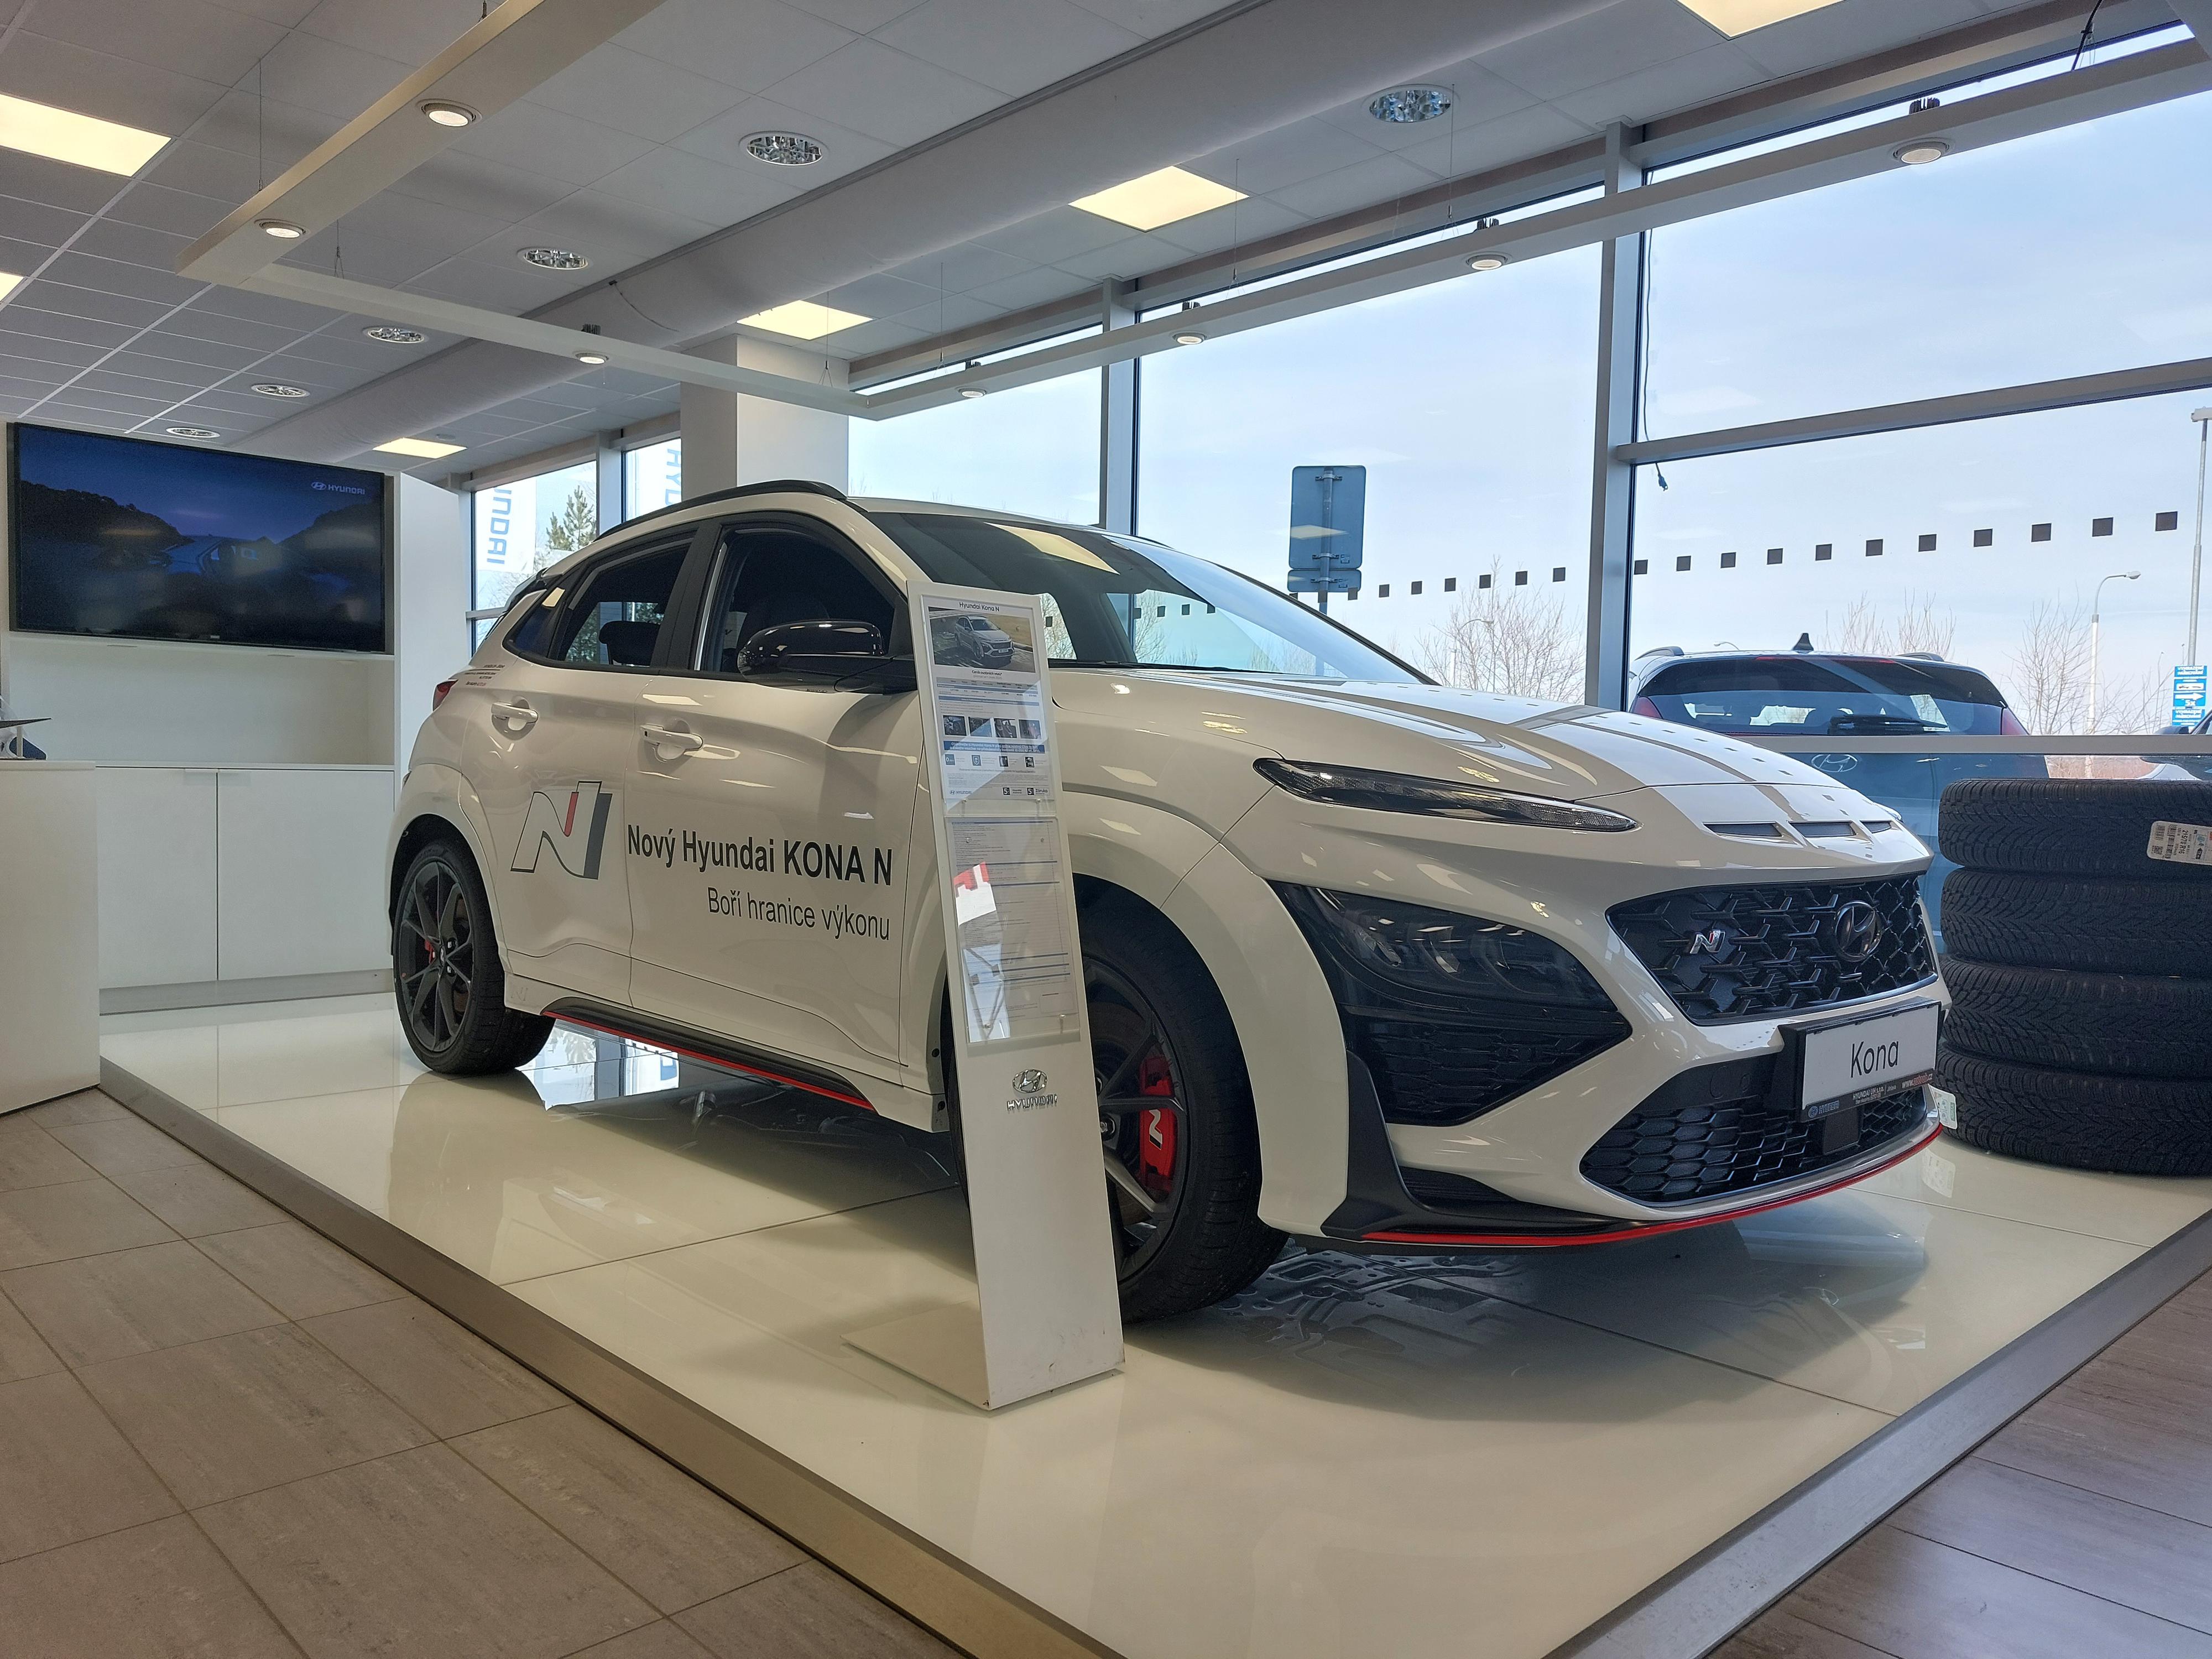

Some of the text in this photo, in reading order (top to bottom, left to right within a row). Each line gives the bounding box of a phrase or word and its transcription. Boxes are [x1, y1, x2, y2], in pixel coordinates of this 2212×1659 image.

[328, 484, 365, 494] HYUNDAI
[628, 824, 892, 886] Nový Hyundai KONA N
[707, 886, 889, 940] Boří hranice výkonu
[1851, 1041, 1899, 1078] Kona
[1006, 1094, 1057, 1111] HYUNDAI
